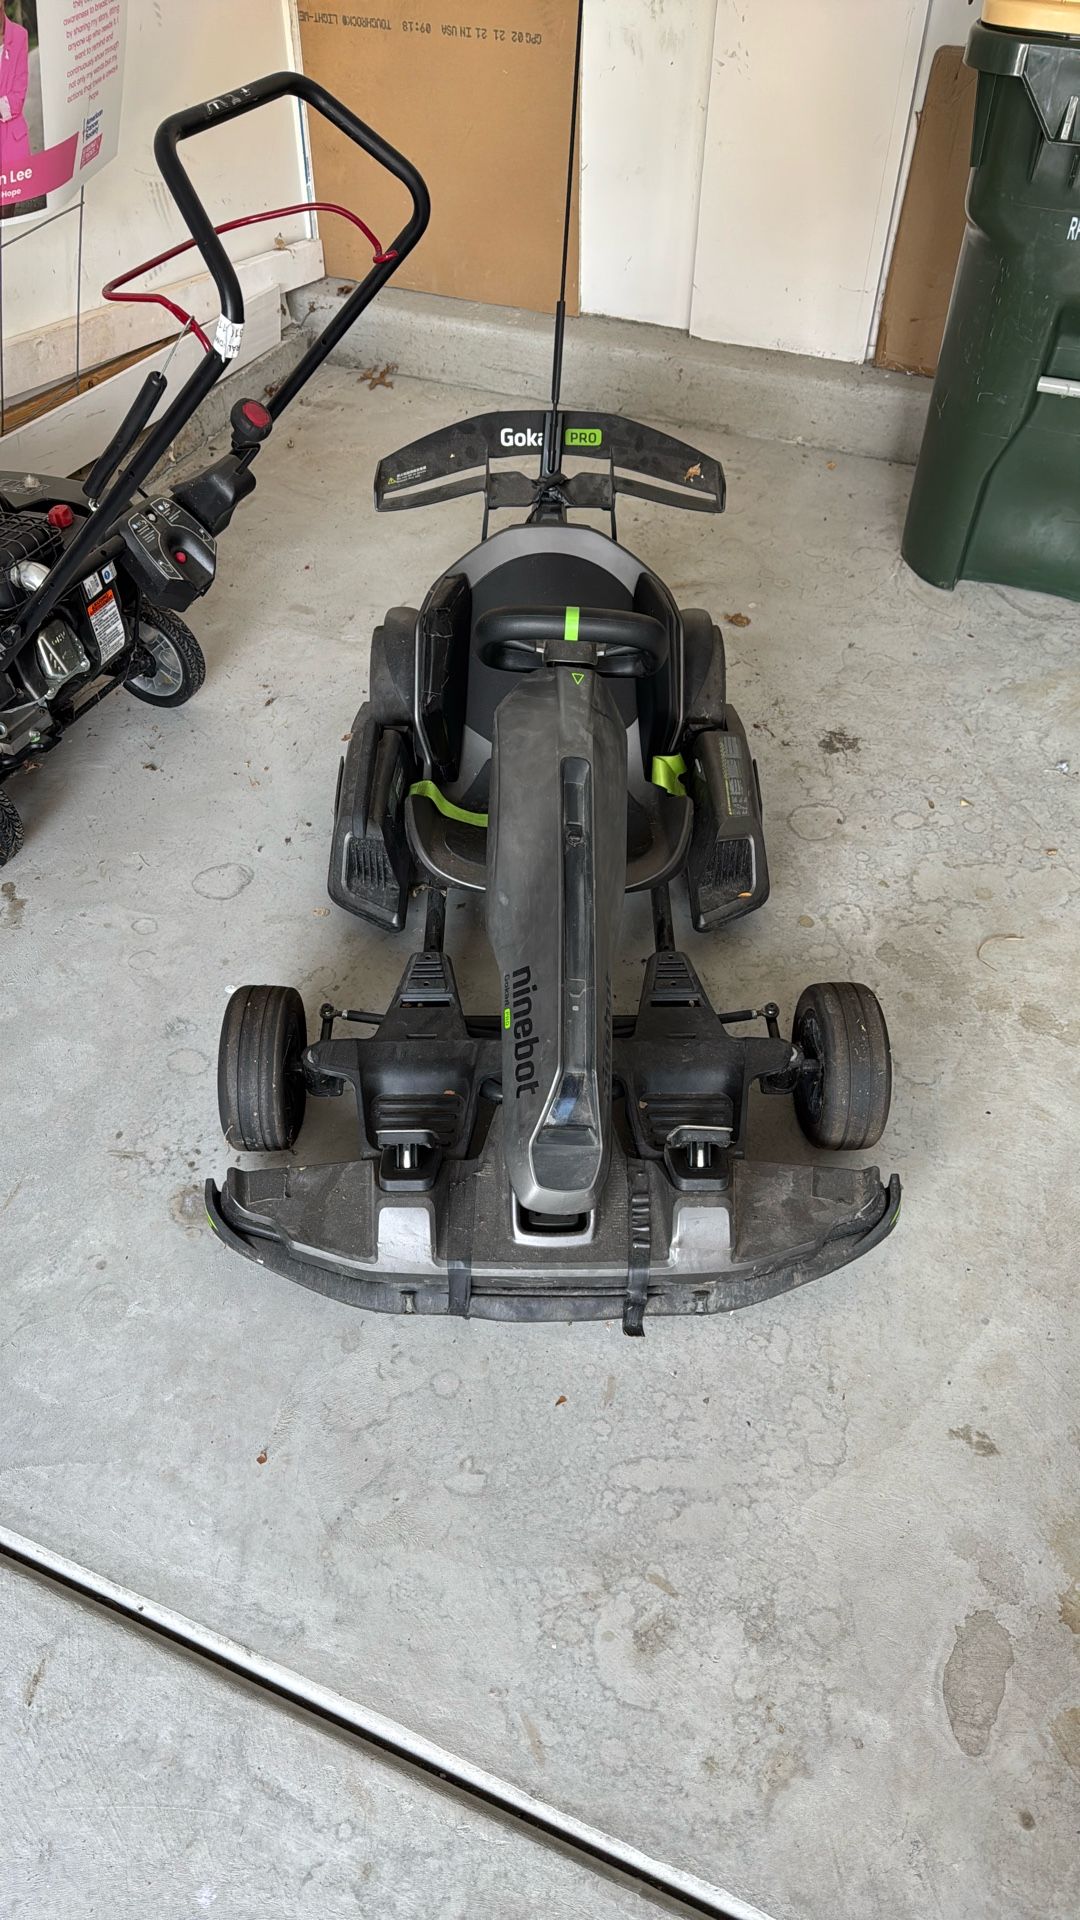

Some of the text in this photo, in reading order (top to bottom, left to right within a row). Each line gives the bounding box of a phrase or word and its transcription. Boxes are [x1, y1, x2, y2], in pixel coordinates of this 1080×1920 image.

[402, 20, 431, 34] 09:18
[441, 24, 457, 36] USA
[459, 26, 472, 38] IN
[475, 27, 487, 40] 21
[493, 29, 505, 41] 21
[511, 31, 524, 43] 02
[10, 168, 32, 183] Lee
[1, 189, 21, 198] Hope
[500, 427, 597, 447] Goka PRO
[512, 966, 540, 1099] ninebot
